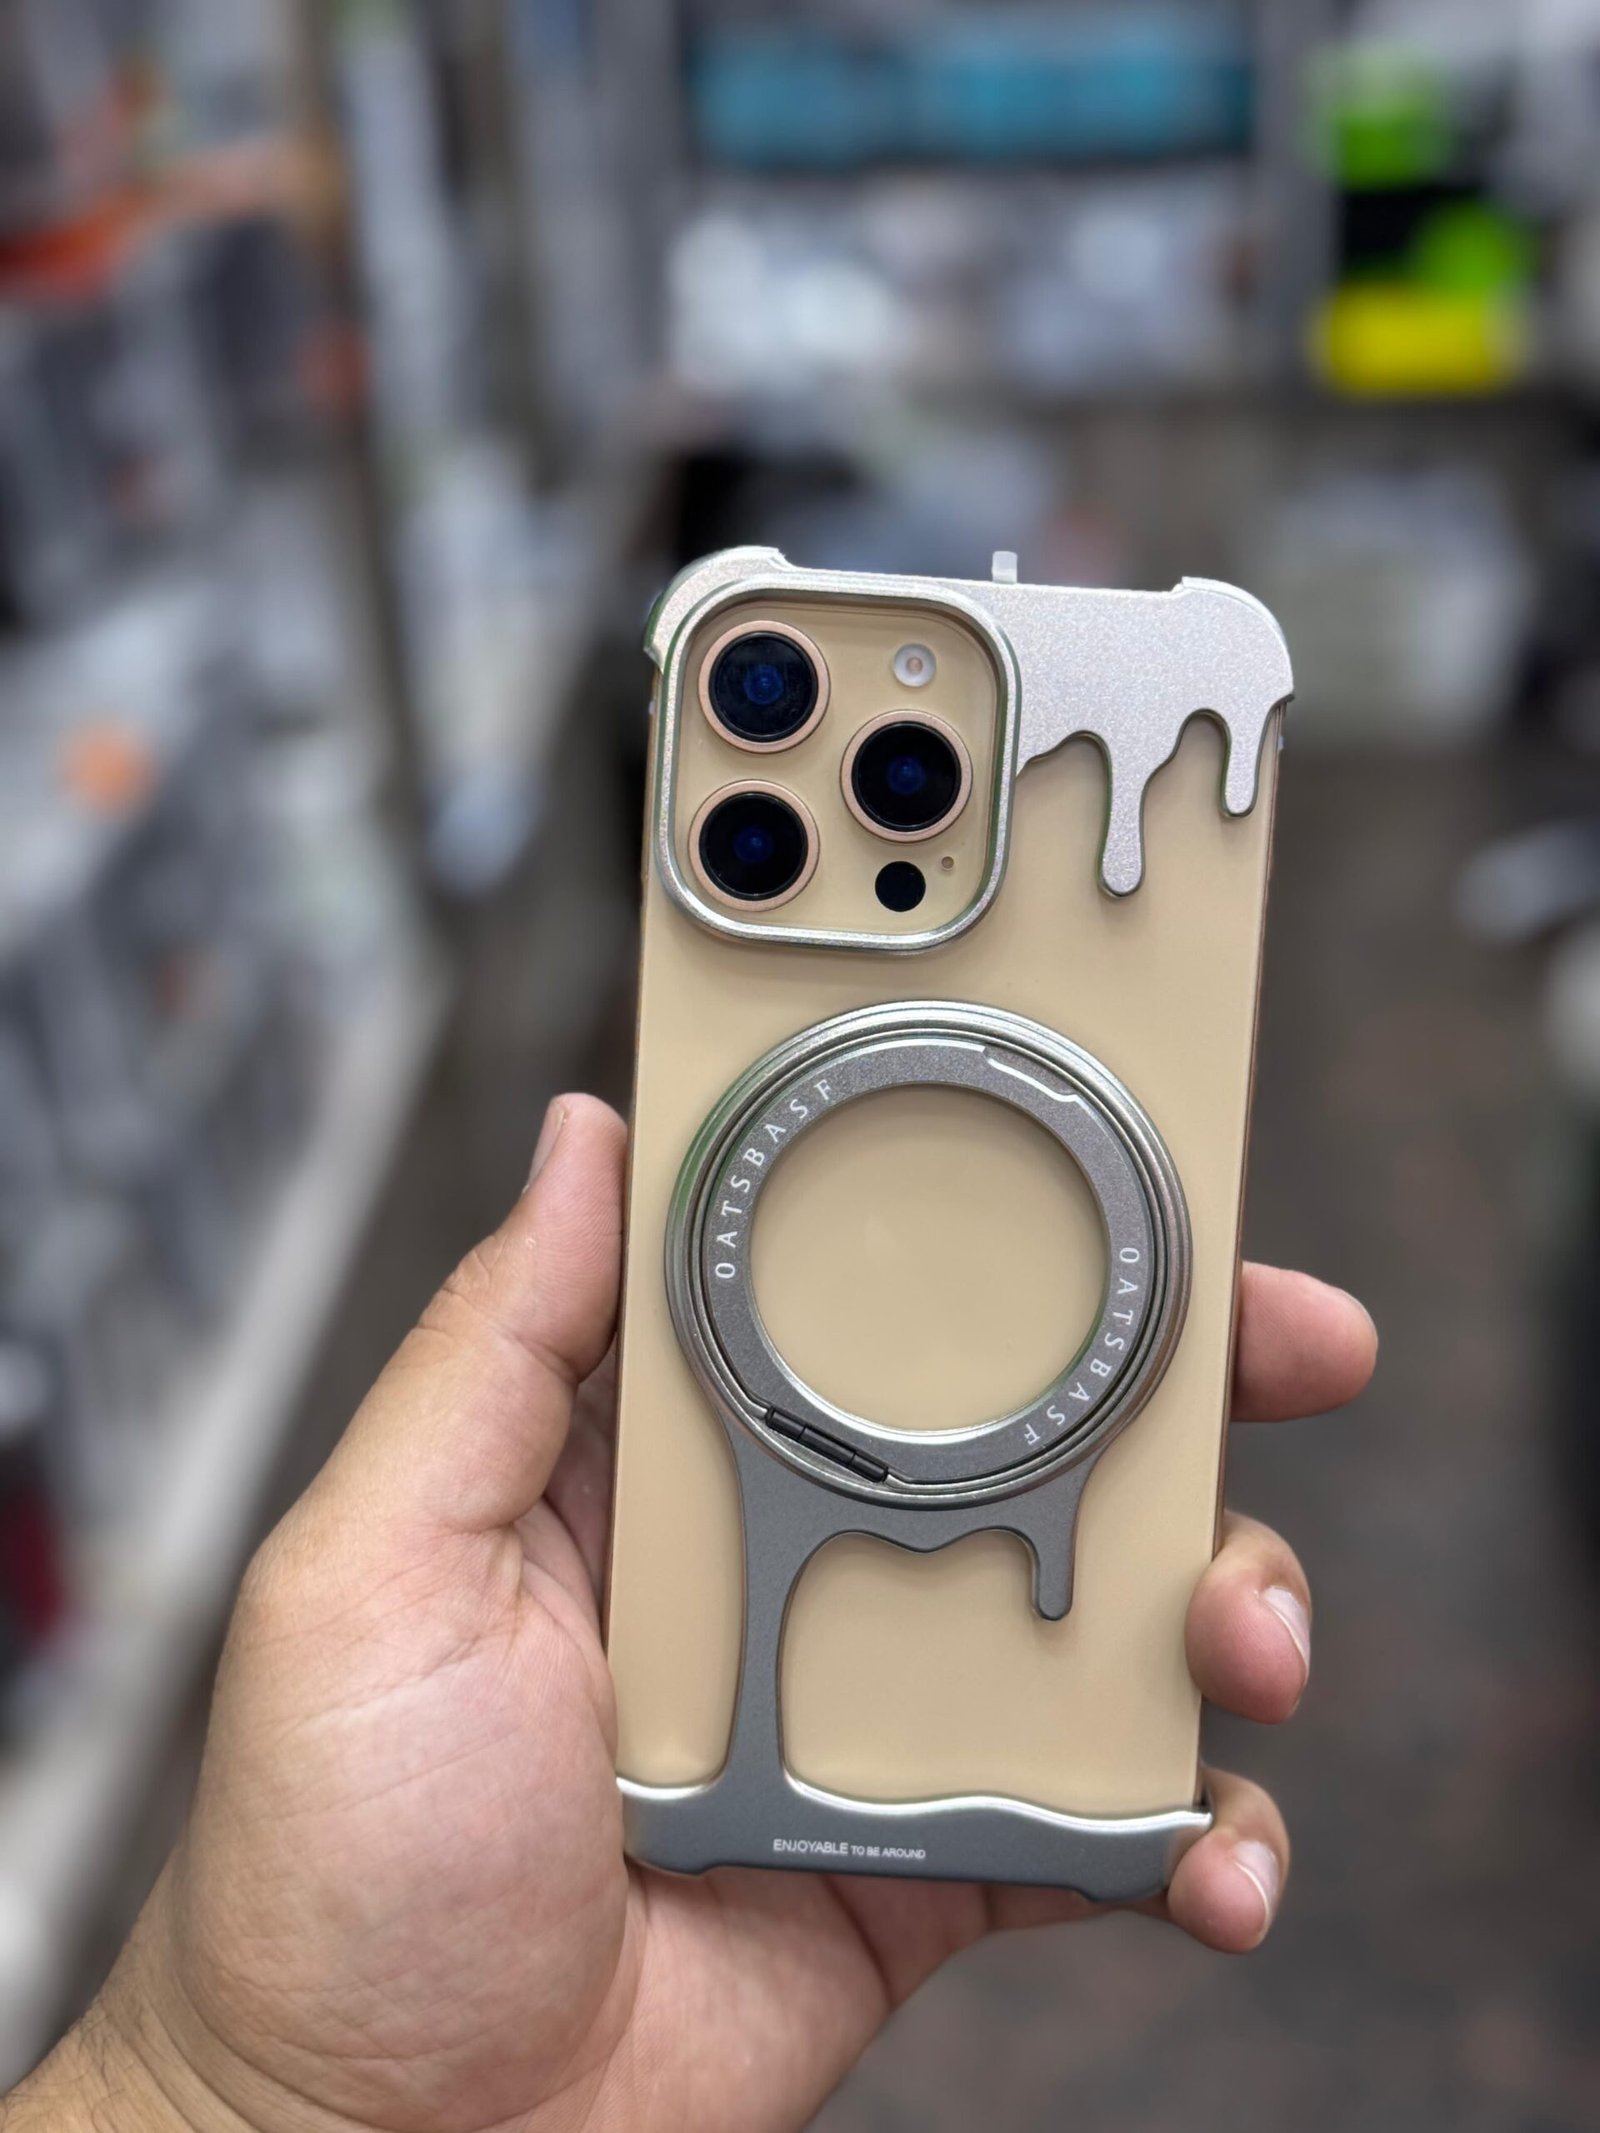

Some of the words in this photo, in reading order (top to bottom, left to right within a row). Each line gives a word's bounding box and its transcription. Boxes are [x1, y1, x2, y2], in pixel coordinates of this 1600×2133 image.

[714, 1078, 832, 1280] OATSBASF
[1023, 1246, 1141, 1446] OATSBASF
[773, 1838, 849, 1855] ENJOYABLE
[851, 1845, 865, 1856] TO
[866, 1846, 881, 1857] BE
[881, 1847, 926, 1860] AROUND
